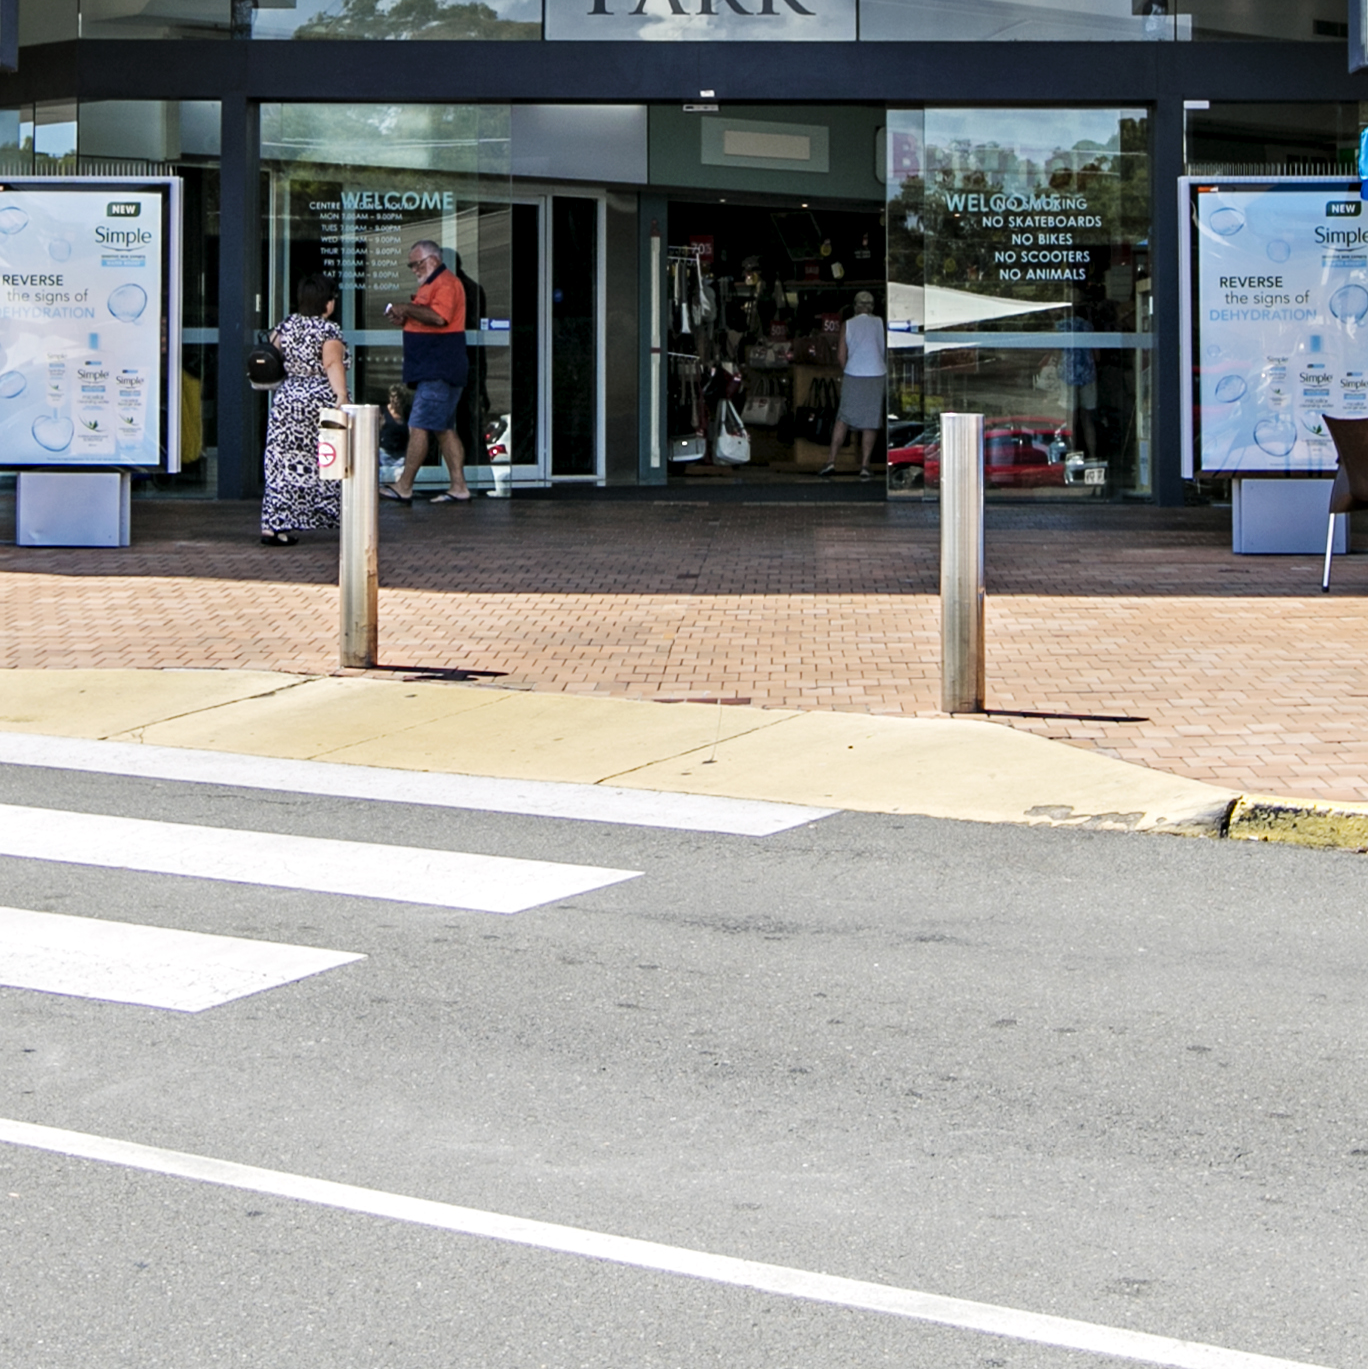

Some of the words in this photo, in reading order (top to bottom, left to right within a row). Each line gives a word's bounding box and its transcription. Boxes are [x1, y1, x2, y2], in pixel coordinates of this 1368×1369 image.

[309, 201, 341, 210] CENTRE
[341, 191, 454, 210] WELCOME
[996, 198, 1018, 210] NO
[1023, 198, 1088, 210] SMOKING
[111, 205, 136, 214] NEW
[1331, 204, 1356, 213] NEW
[321, 224, 338, 232] TUES
[982, 216, 1004, 228] NO
[1008, 216, 1102, 228] SKATEBOARDS
[95, 226, 152, 247] Simple
[1012, 233, 1033, 245] NO
[1038, 233, 1073, 245] BIKES
[994, 251, 1016, 263] NO
[1021, 251, 1090, 263] SCOOTERS
[2, 274, 64, 286] REVERSE
[999, 268, 1021, 280] NO
[1026, 268, 1086, 280] ANIMALS
[1219, 276, 1283, 288] REVERSE
[7, 289, 30, 302] the
[35, 290, 70, 305] signs
[74, 289, 89, 302] of
[1225, 291, 1249, 304] the
[1253, 292, 1290, 307] signs
[1295, 290, 1310, 303] of
[1209, 309, 1317, 321] DEHYDRATION
[77, 368, 109, 381] Simple
[1299, 372, 1333, 385] Simple
[1340, 379, 1368, 390] Simple
